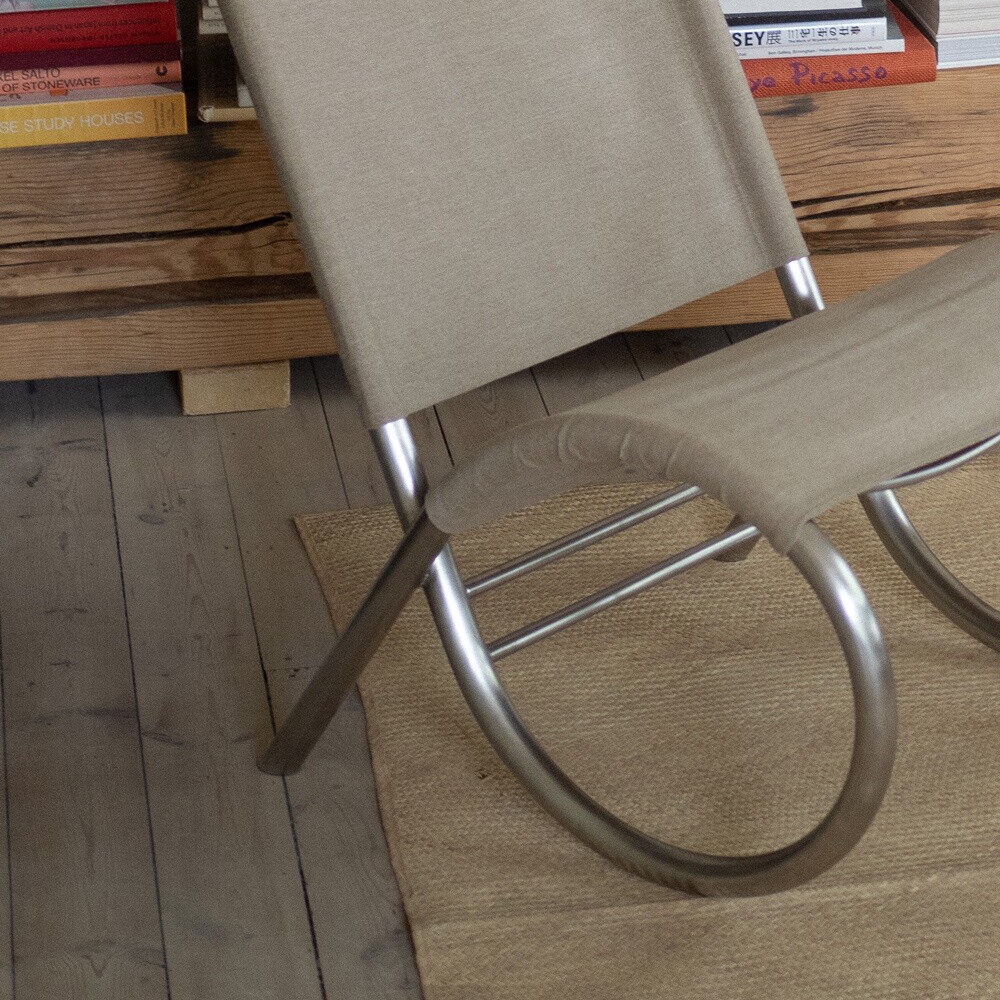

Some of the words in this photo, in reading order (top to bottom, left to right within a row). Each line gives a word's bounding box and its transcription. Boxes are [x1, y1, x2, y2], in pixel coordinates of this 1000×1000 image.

[21, 67, 61, 80] SALTO
[788, 60, 889, 86] Picasso
[2, 82, 19, 93] OF
[22, 76, 101, 92] STONEWARE
[23, 116, 75, 133] STUDY
[79, 110, 145, 127] HOUSES
